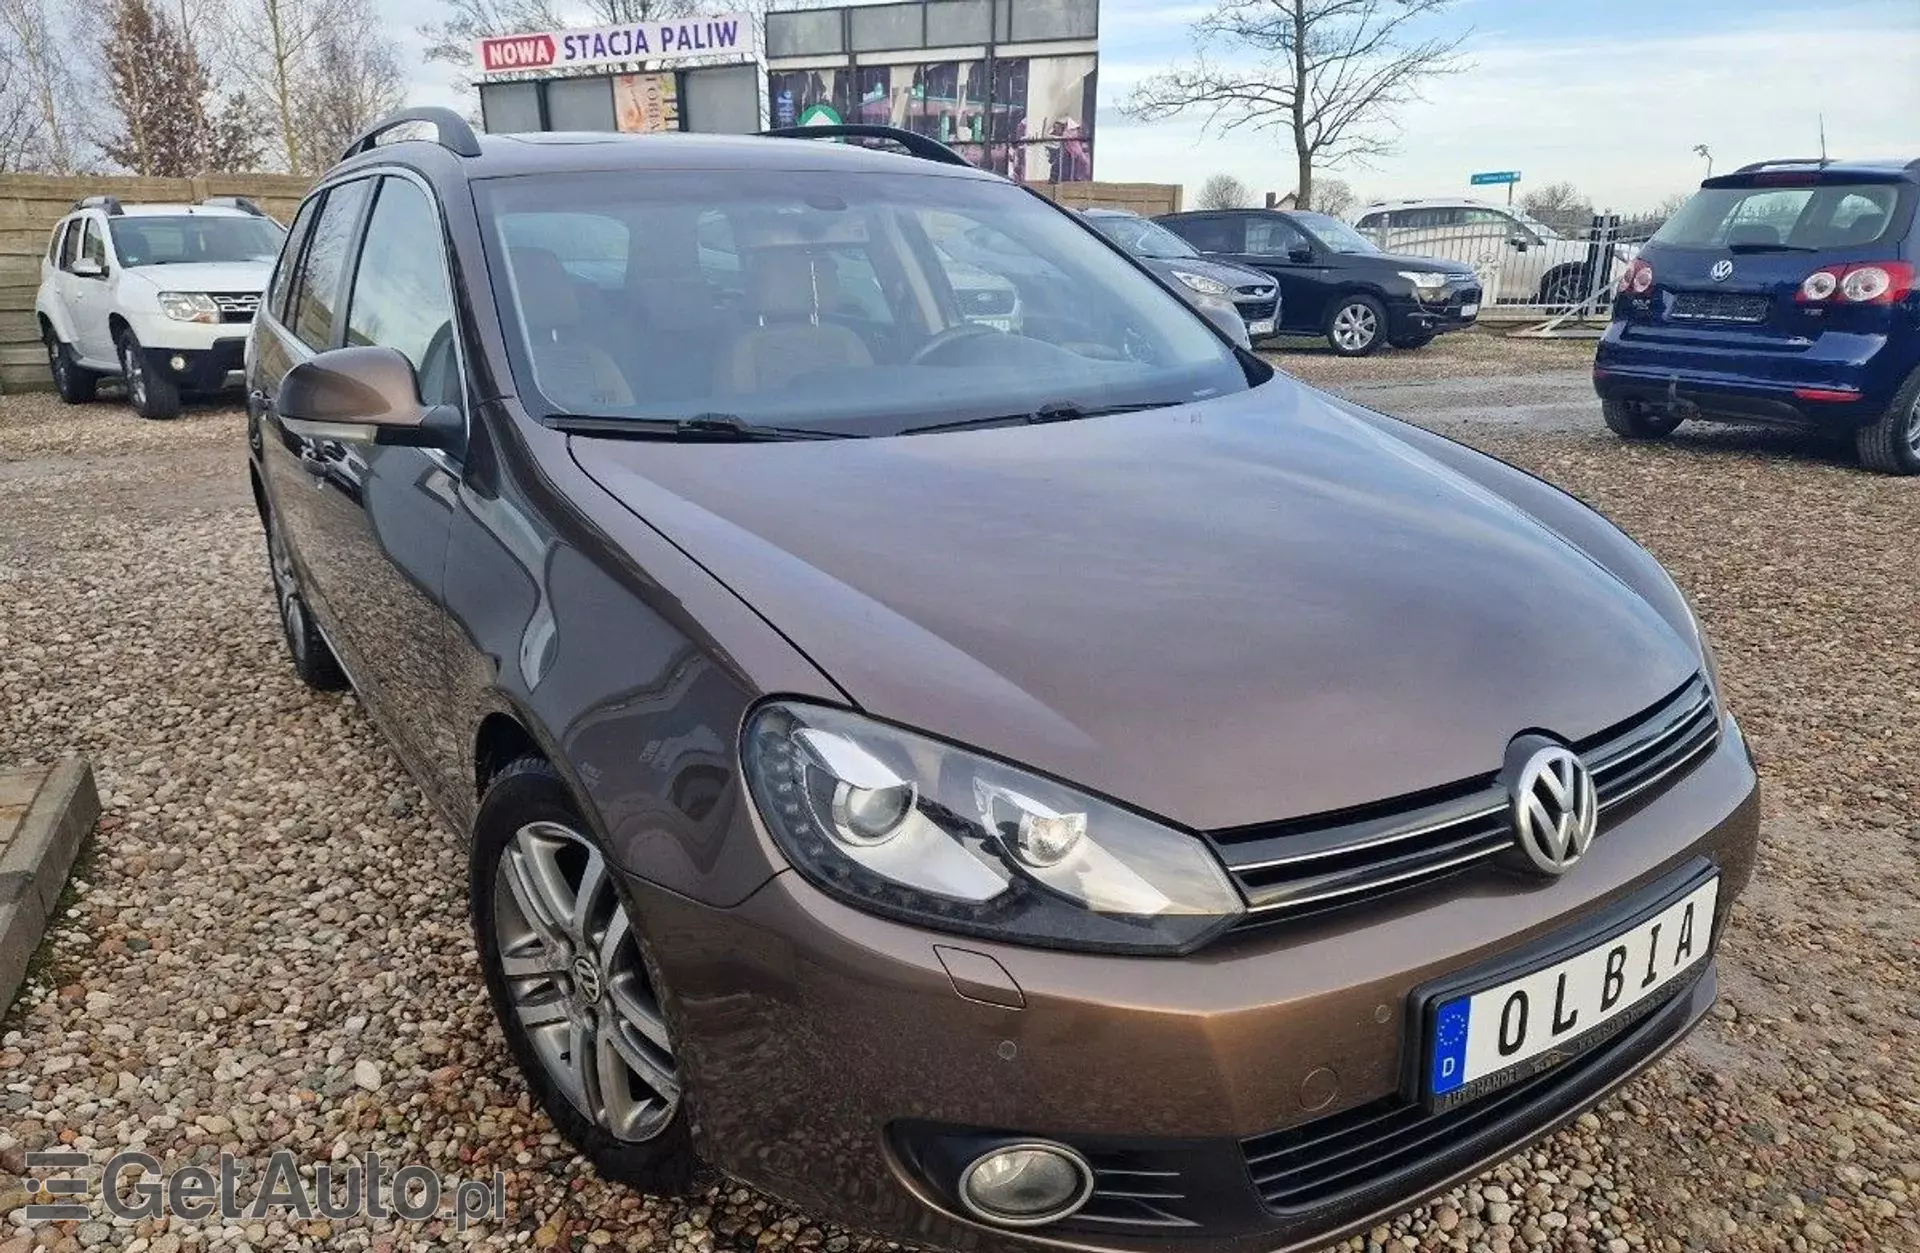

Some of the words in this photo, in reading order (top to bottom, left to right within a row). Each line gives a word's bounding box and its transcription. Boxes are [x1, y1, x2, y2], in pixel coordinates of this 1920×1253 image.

[489, 40, 550, 66] NOWA
[564, 28, 649, 61] STACJA
[661, 20, 739, 52] PALIW
[1520, 750, 1594, 870] VW
[1498, 901, 1695, 1057] OLBIA
[1441, 1057, 1455, 1078] D
